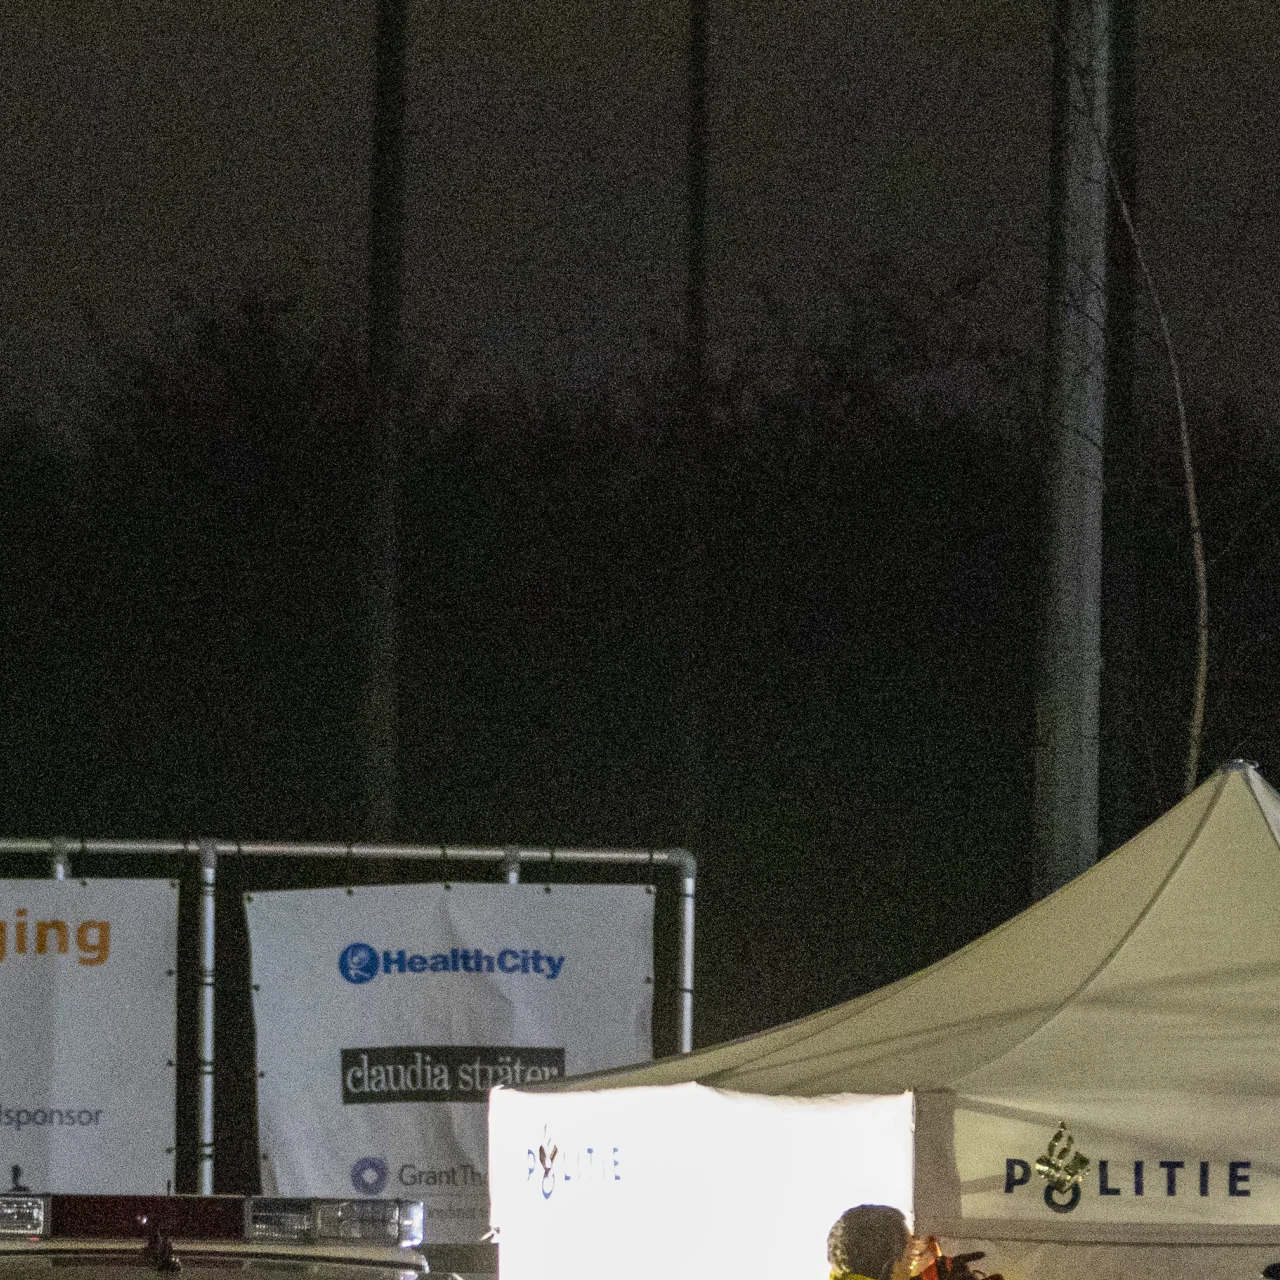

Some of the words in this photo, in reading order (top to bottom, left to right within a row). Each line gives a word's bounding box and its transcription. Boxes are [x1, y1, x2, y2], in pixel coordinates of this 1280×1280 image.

[381, 948, 566, 980] HealthCity
[346, 1053, 450, 1093] claudia
[398, 1163, 457, 1187] Grant
[458, 1163, 484, 1187] Th
[1004, 1156, 1253, 1213] POLITIE
